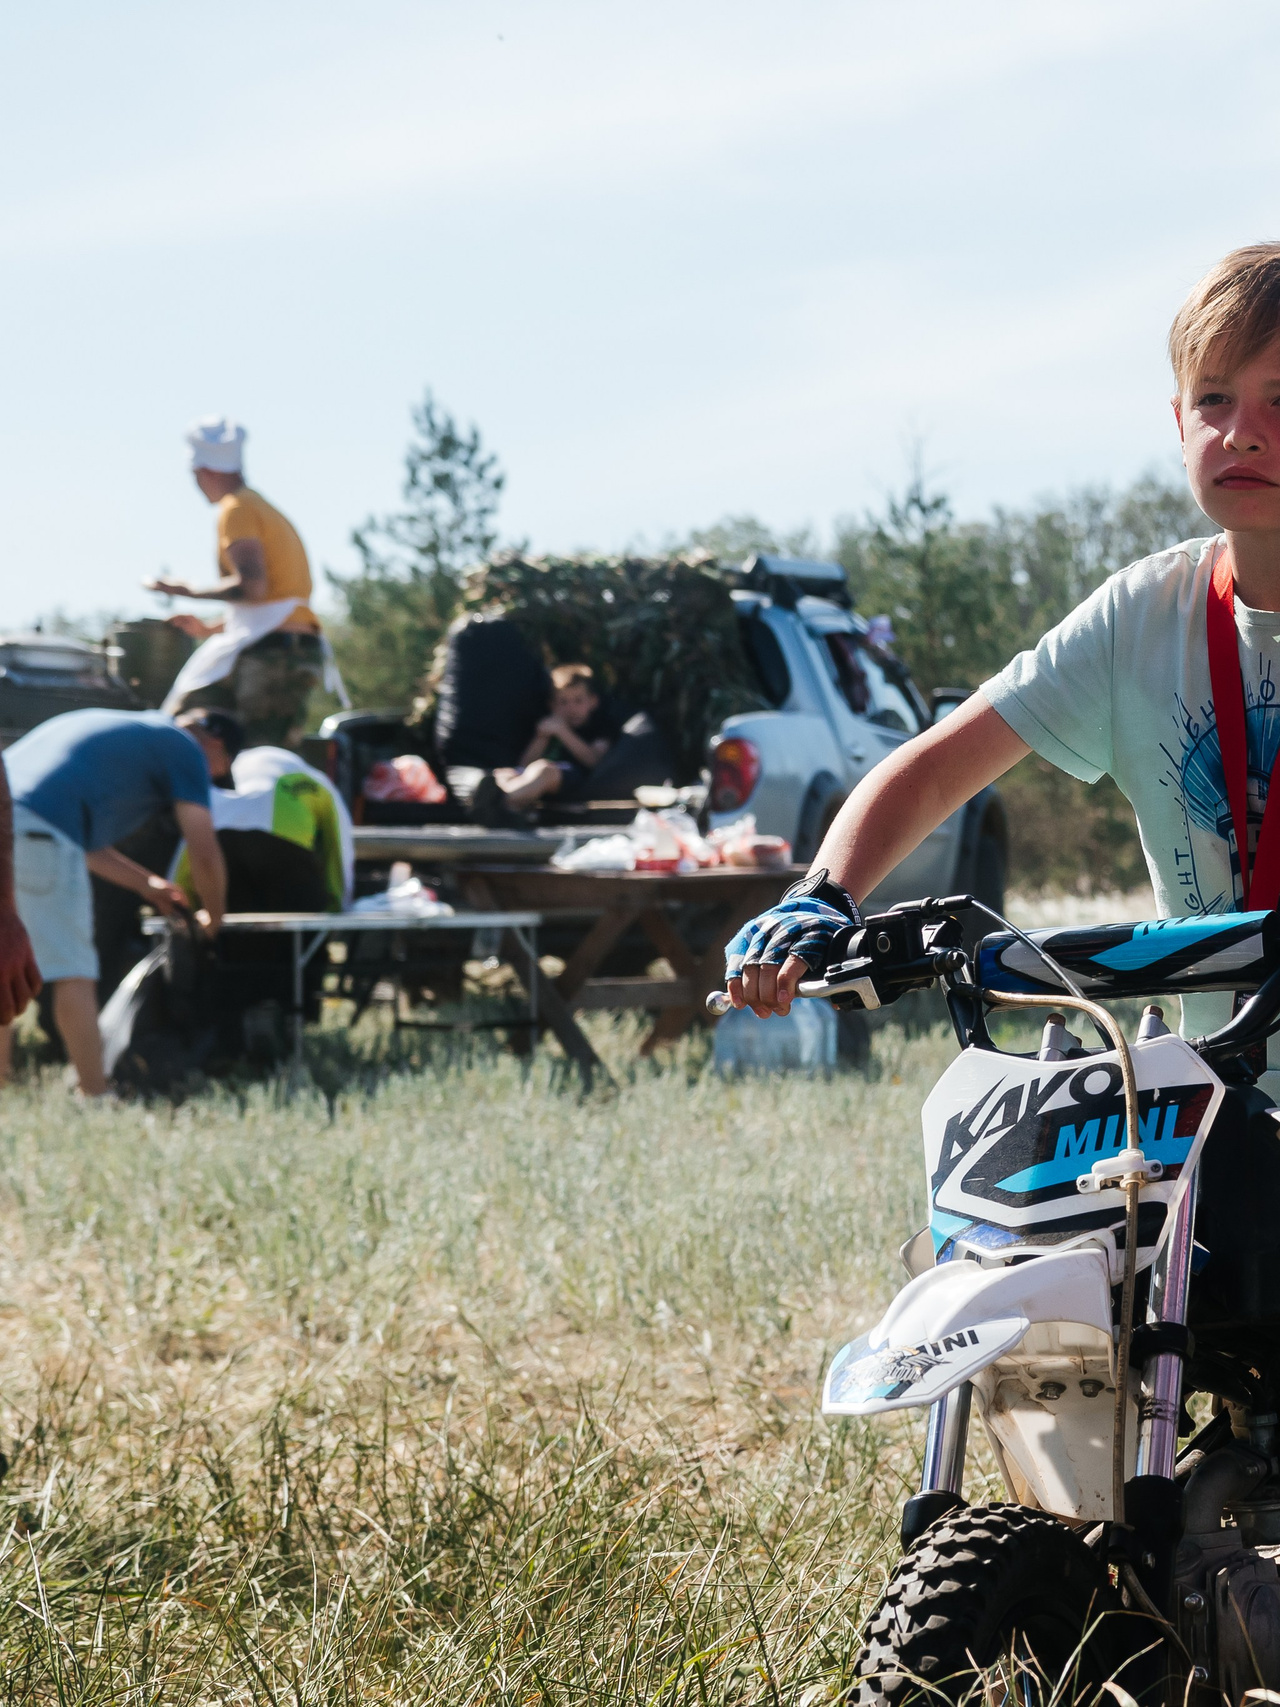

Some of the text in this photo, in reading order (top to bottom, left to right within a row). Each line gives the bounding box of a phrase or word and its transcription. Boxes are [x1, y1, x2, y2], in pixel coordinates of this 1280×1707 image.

[1174, 847, 1200, 911] GHT
[934, 1062, 1126, 1174] KAYO
[1053, 1104, 1180, 1162] MINI
